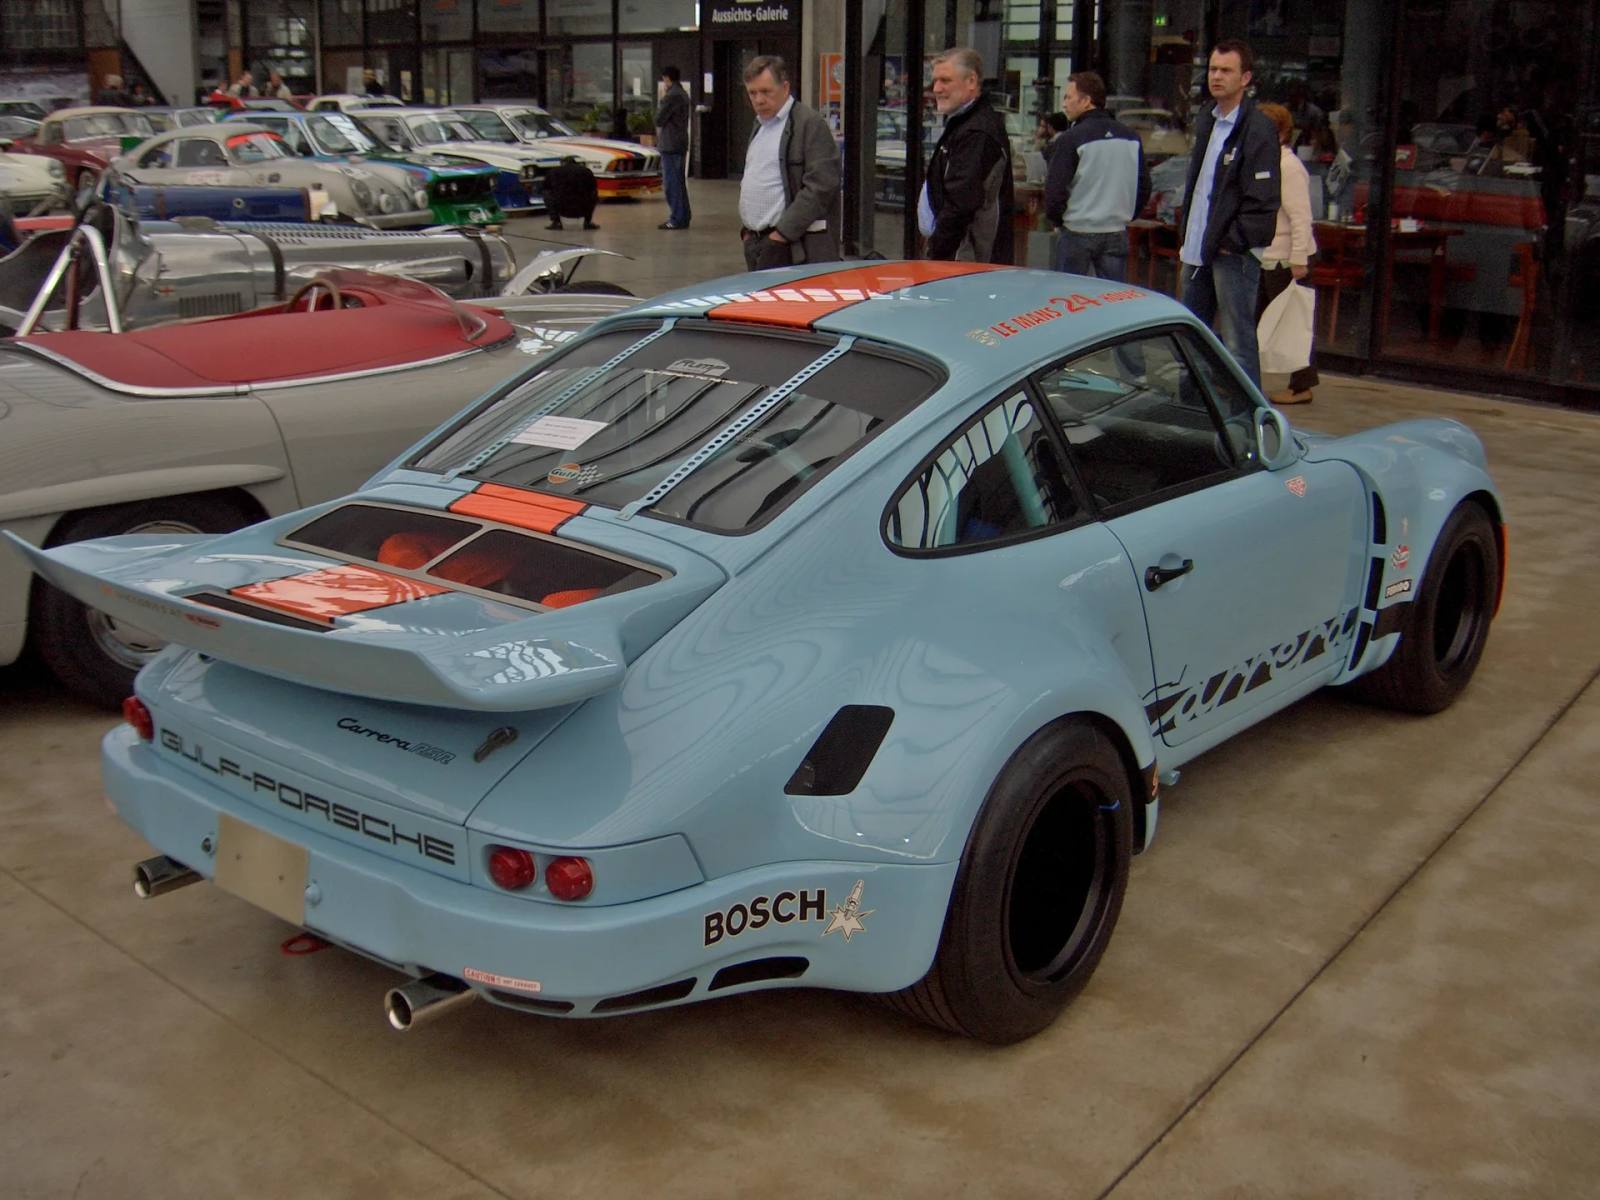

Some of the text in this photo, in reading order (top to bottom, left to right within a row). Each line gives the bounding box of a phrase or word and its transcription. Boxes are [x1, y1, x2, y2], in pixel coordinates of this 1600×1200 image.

[711, 5, 789, 22] Aussichts-Galerie
[991, 322, 1019, 338] LE
[1012, 306, 1063, 330] MANS
[1048, 294, 1101, 314] 24
[551, 467, 582, 482] Gulf
[336, 717, 411, 751] Carrera
[159, 727, 456, 866] GULF-PORSCHE
[704, 888, 826, 947] BOSCH
